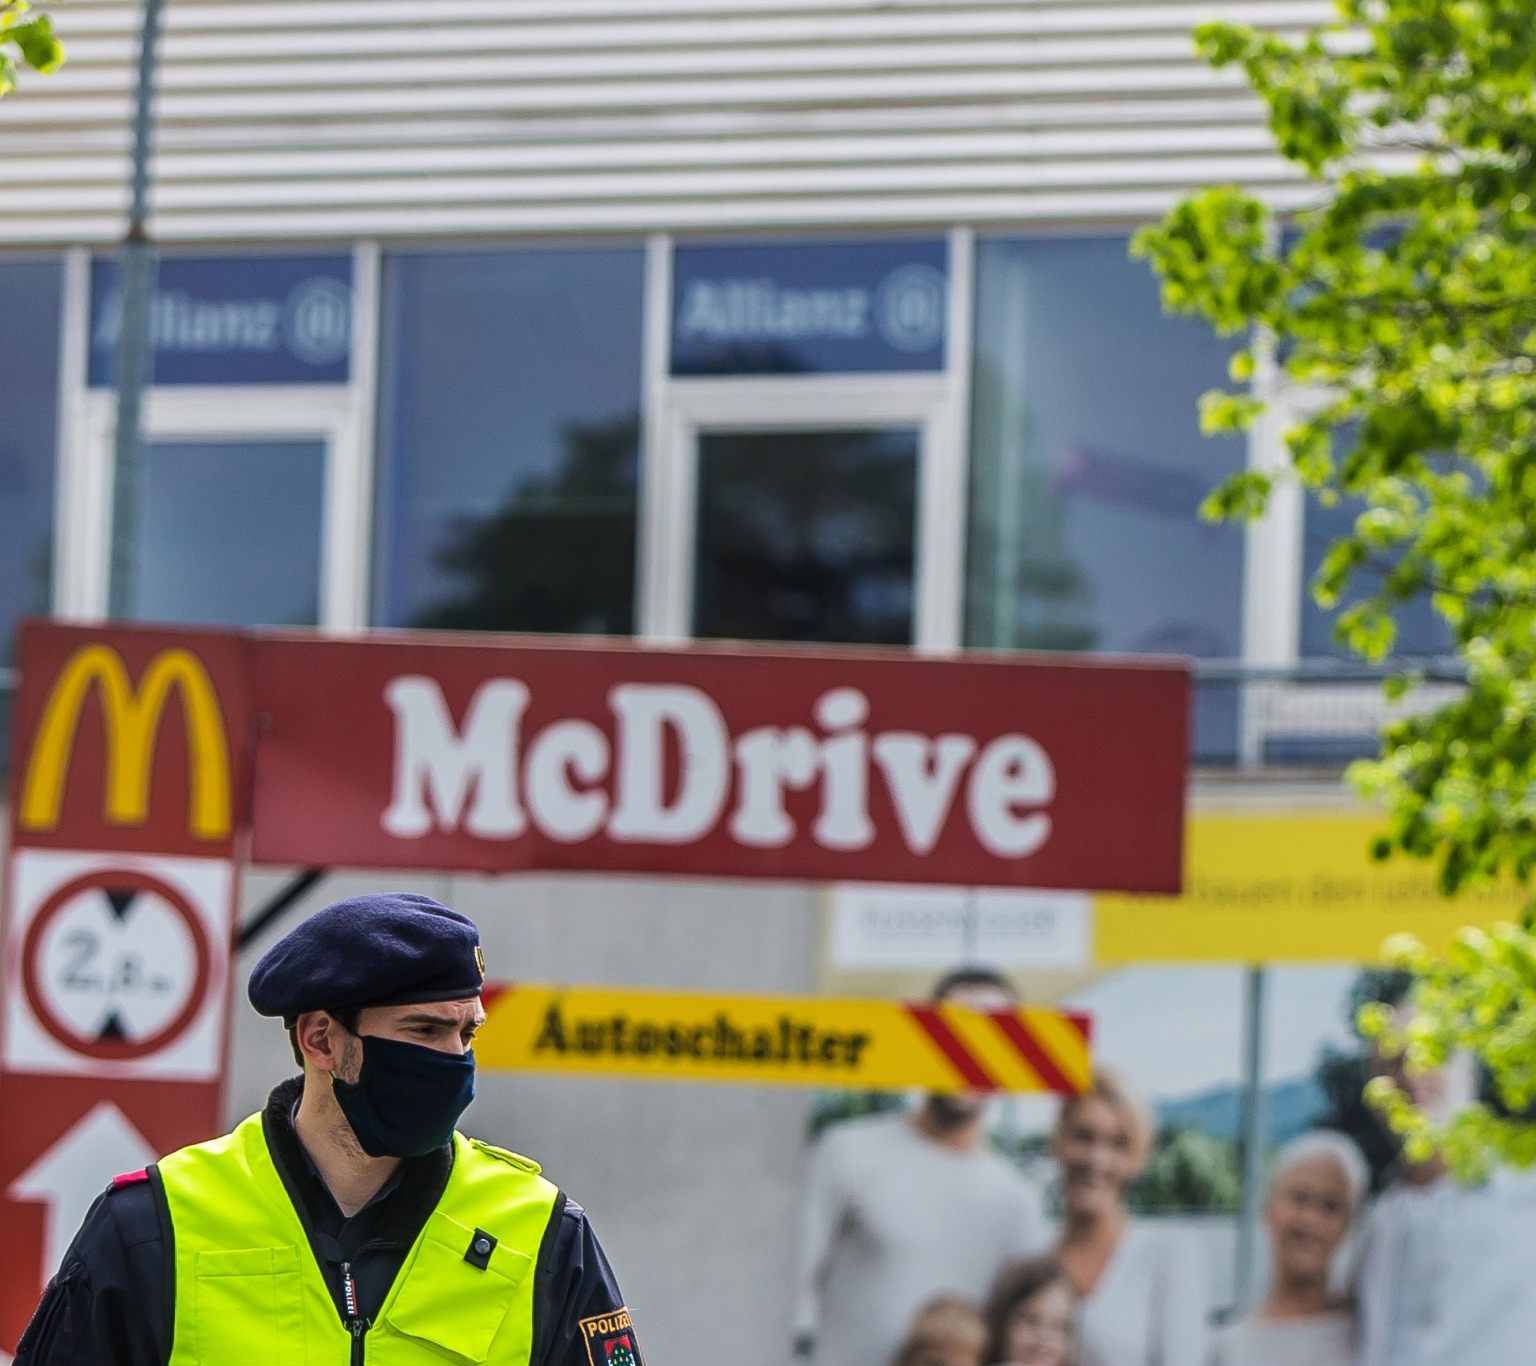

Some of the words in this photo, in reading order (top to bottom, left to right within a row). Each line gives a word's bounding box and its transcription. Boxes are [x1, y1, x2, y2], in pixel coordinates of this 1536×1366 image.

[680, 278, 869, 339] Allianz
[381, 675, 1056, 857] McDrive
[534, 1003, 869, 1066] Autoschalter
[344, 1280, 355, 1314] POLIZEI
